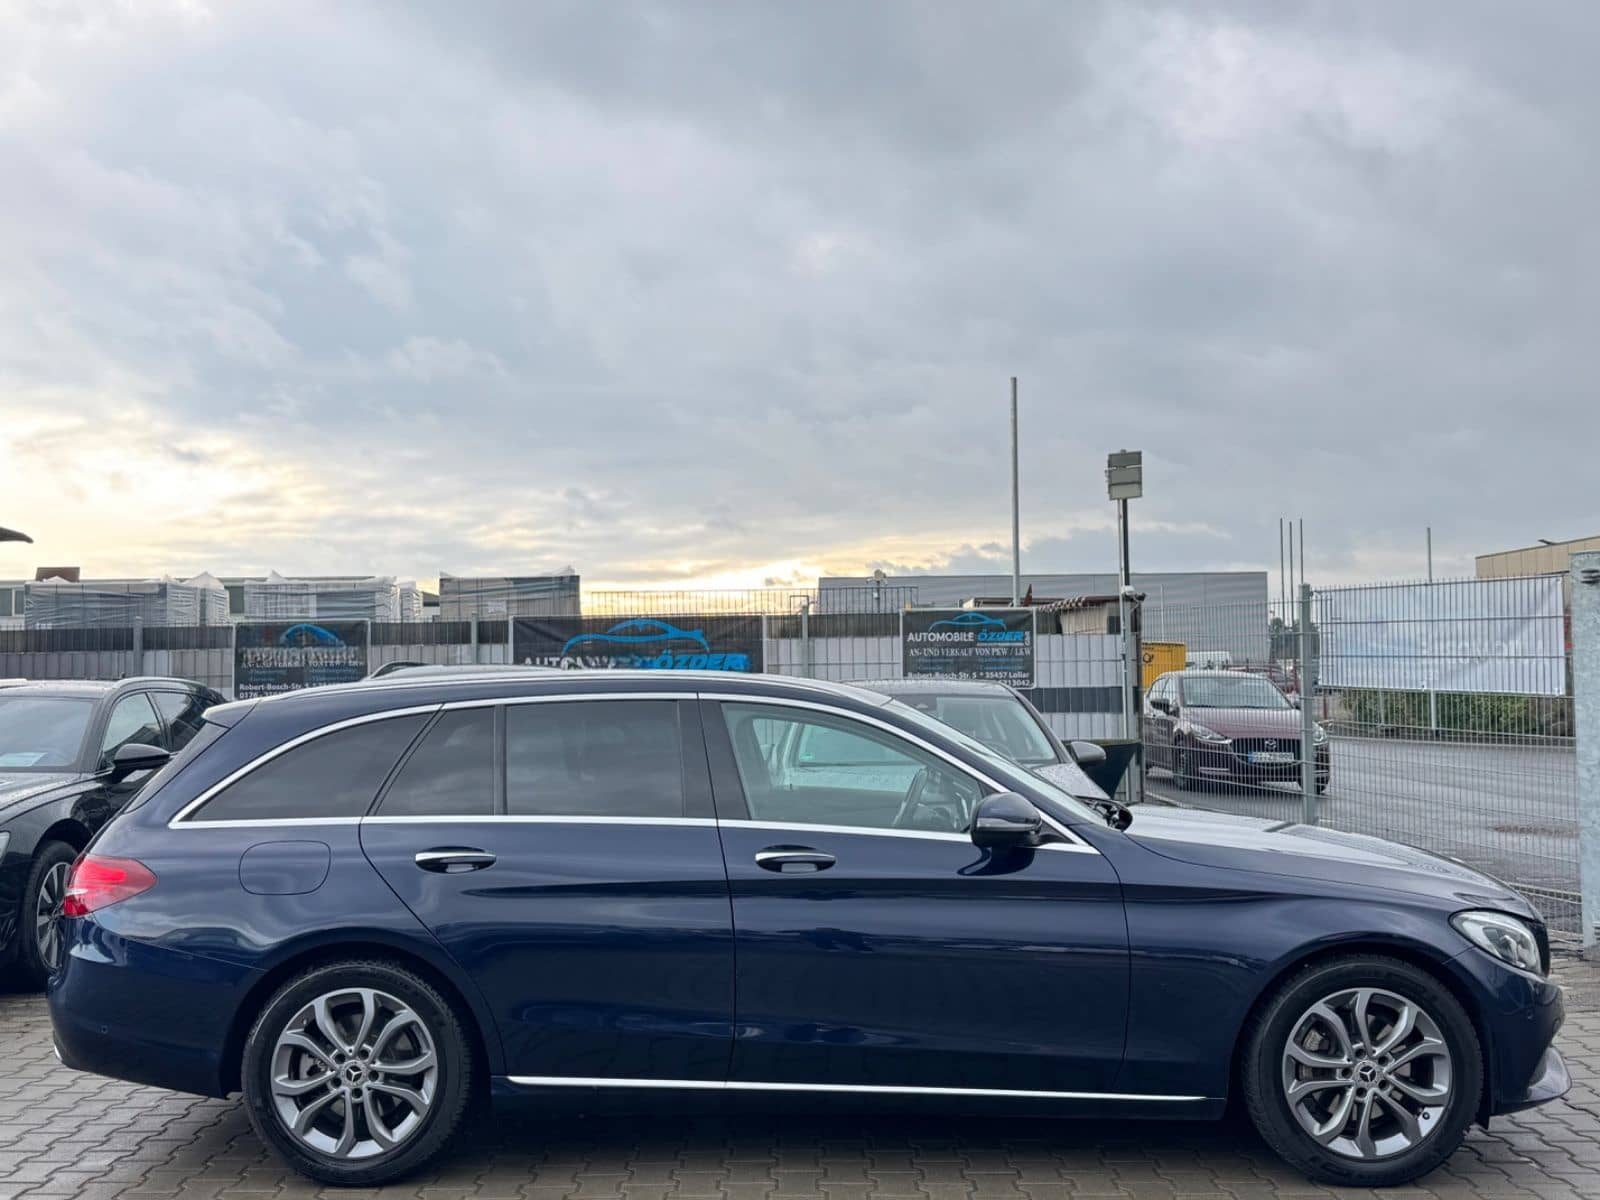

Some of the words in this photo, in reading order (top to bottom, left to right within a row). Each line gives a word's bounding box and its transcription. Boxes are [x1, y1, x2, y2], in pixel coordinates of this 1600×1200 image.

[907, 632, 974, 642] AUTOMOBILE
[977, 629, 1024, 642] ÖZDER
[909, 648, 922, 657] AN-
[923, 648, 939, 657] UND
[941, 647, 972, 657] VERKAUF
[975, 648, 990, 657] VON
[991, 648, 1007, 656] PKW
[1015, 647, 1031, 656] LKW
[654, 649, 749, 672] ÖZDER
[1009, 671, 1030, 679] Lollar
